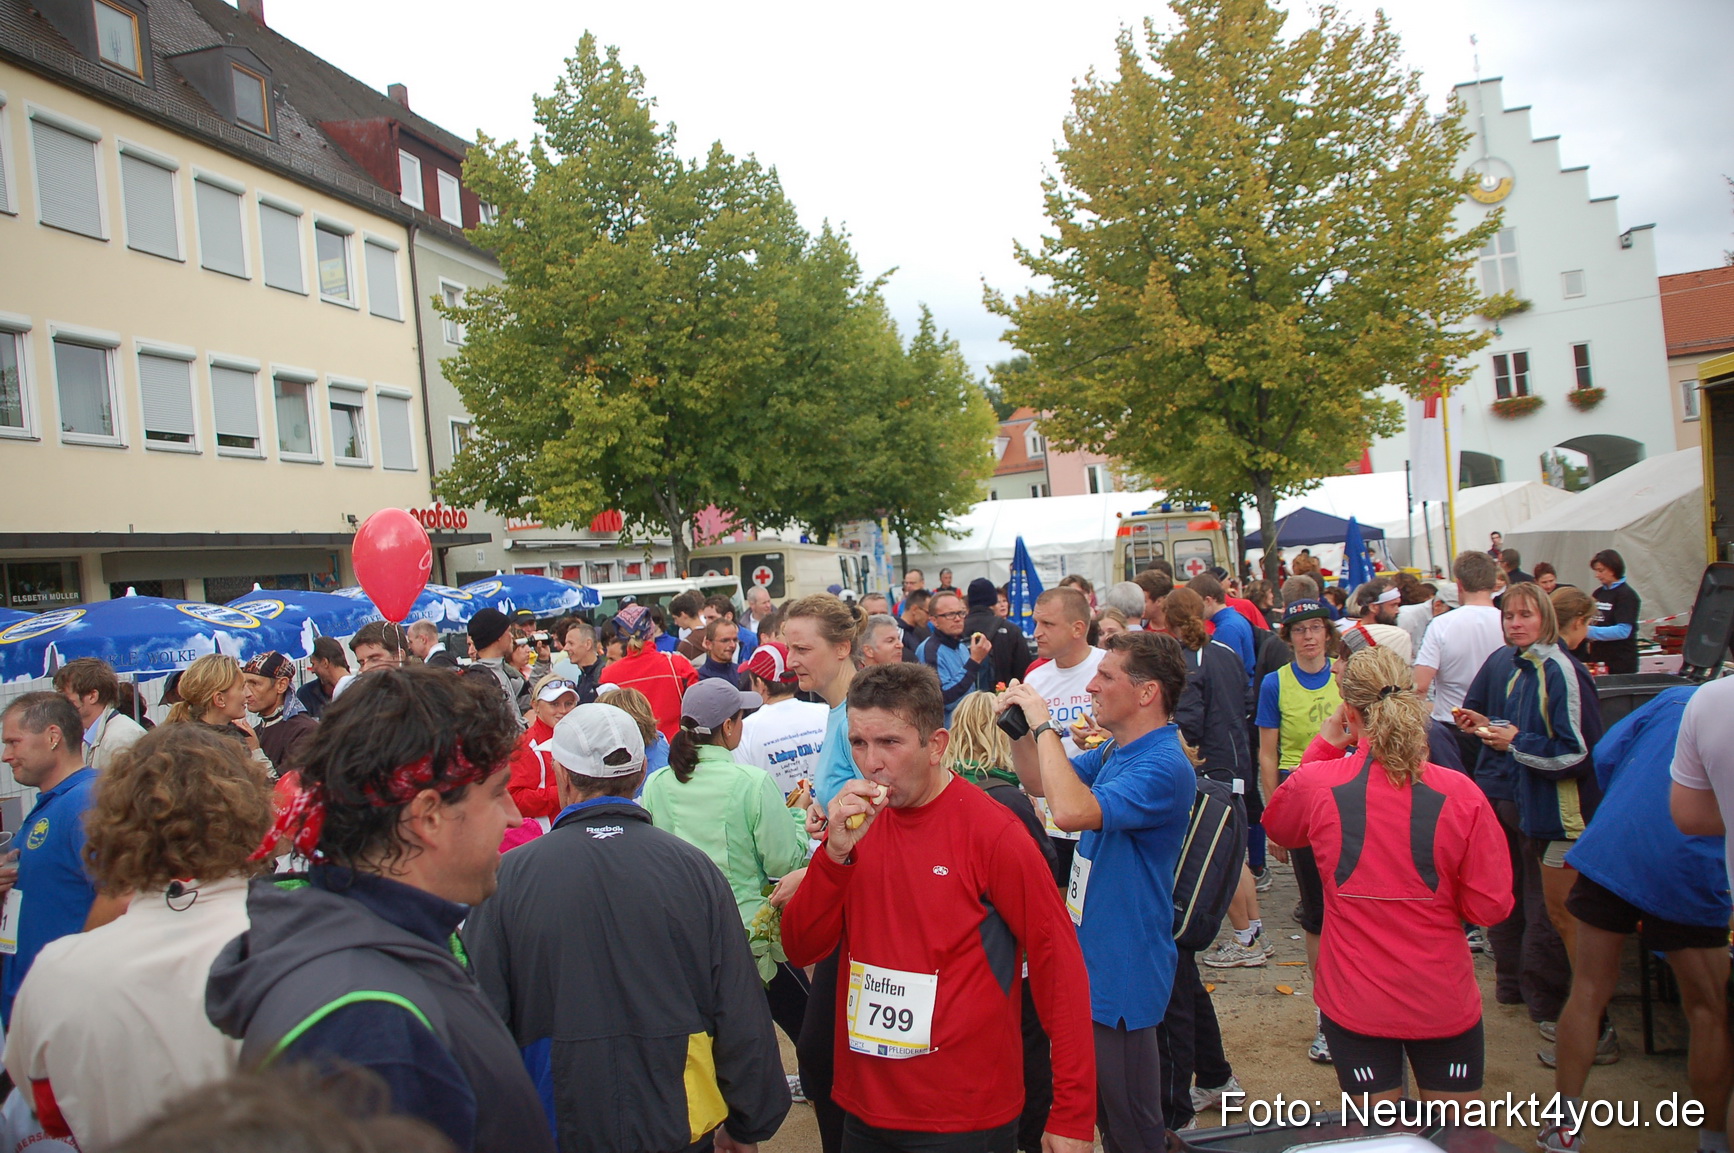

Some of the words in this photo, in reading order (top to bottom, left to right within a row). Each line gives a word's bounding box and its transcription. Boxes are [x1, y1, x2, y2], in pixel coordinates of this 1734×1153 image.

[12, 594, 47, 603] ELSBETH
[50, 592, 79, 600] MÜLLER
[408, 610, 434, 622] OLKE
[147, 649, 197, 665] WOLKE
[1071, 694, 1091, 704] ma
[586, 825, 624, 833] Reebok
[864, 973, 905, 997] Steffen
[869, 1002, 914, 1032] 799
